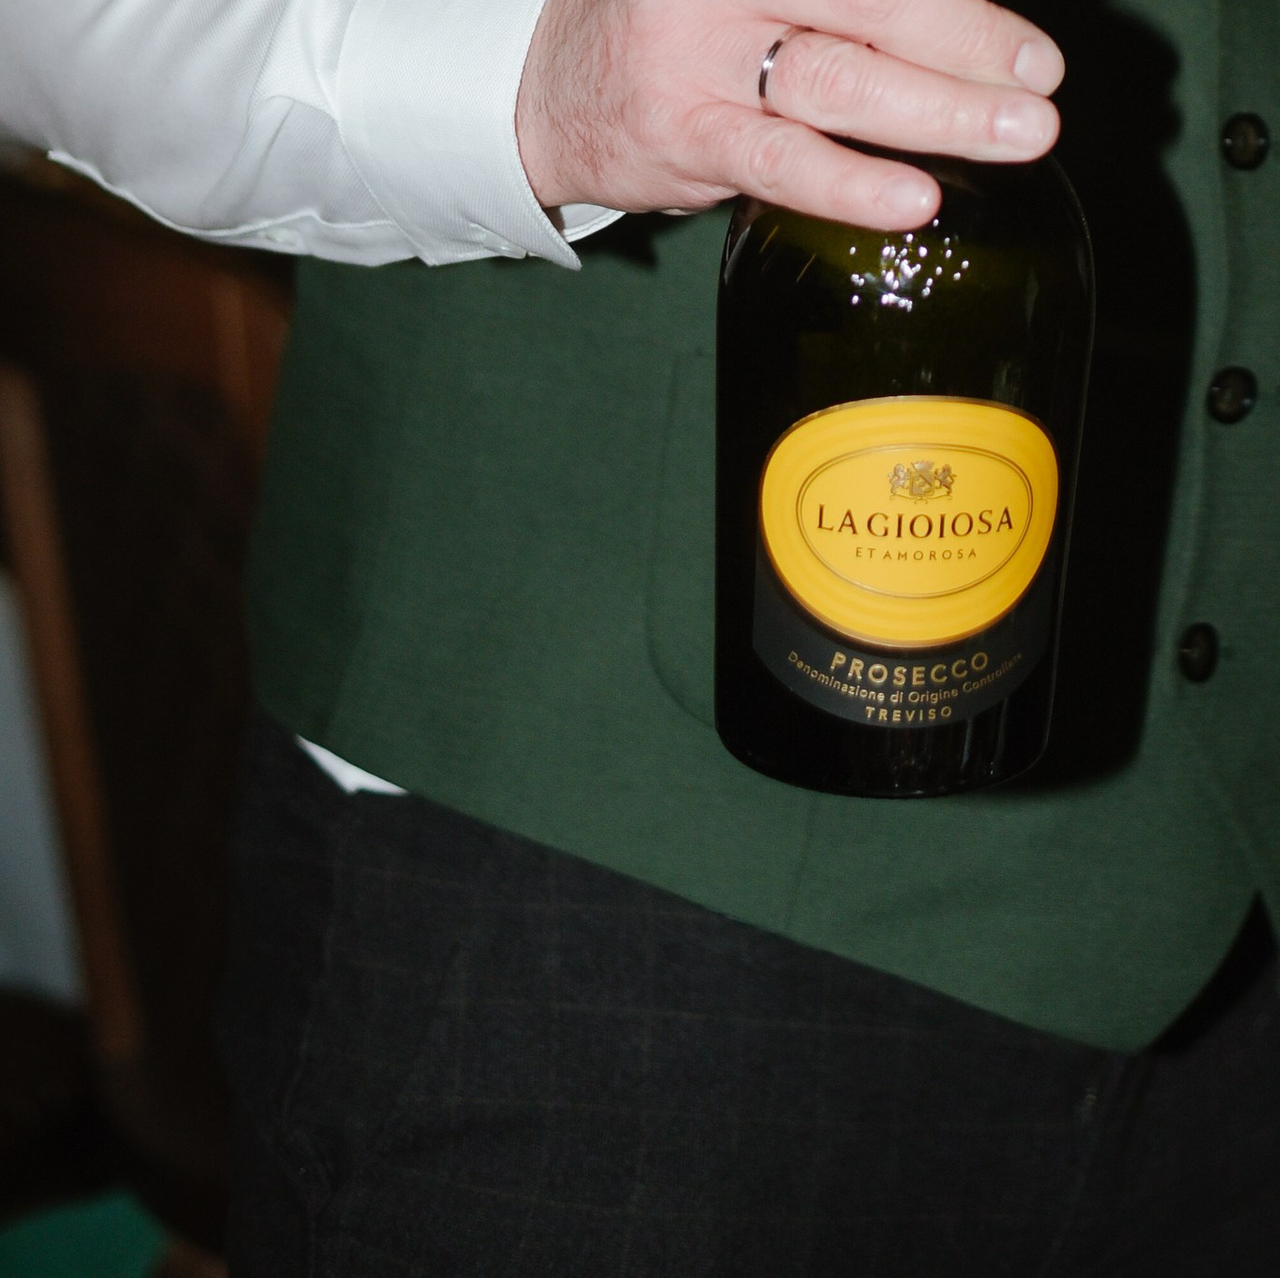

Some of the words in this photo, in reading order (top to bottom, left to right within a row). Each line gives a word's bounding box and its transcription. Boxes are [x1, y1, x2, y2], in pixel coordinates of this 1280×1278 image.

[787, 650, 886, 702] Denominazione
[889, 690, 904, 704] di
[907, 688, 960, 705] Origine
[830, 650, 989, 686] PROSECCO
[865, 705, 953, 722] TREVISO
